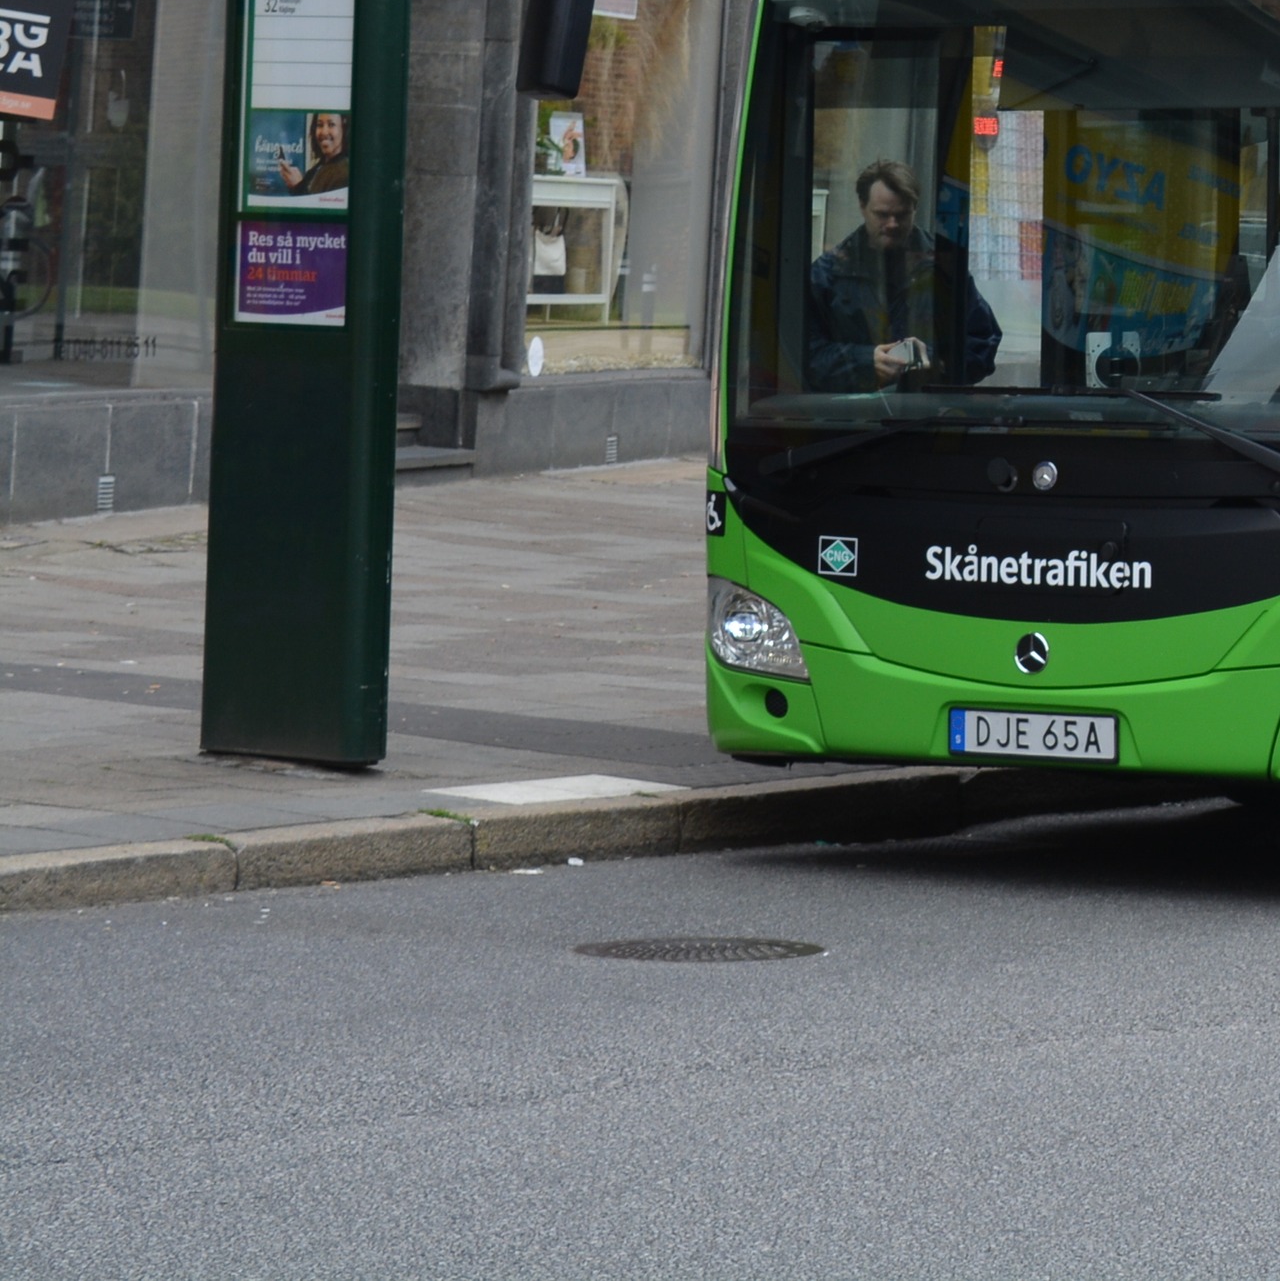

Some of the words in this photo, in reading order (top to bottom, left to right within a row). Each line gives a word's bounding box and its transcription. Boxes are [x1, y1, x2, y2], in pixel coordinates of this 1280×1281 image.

[248, 231, 274, 247] Res
[277, 230, 293, 247] så
[296, 233, 346, 251] mycket
[247, 248, 266, 263] du
[269, 248, 292, 264] vill
[295, 250, 301, 265] i
[247, 266, 263, 280] 24
[267, 267, 318, 282] timmar
[825, 550, 850, 563] CNG
[924, 544, 1152, 589] Skånetrafiken
[976, 715, 1030, 750] DJE
[1042, 720, 1102, 754] 65A
